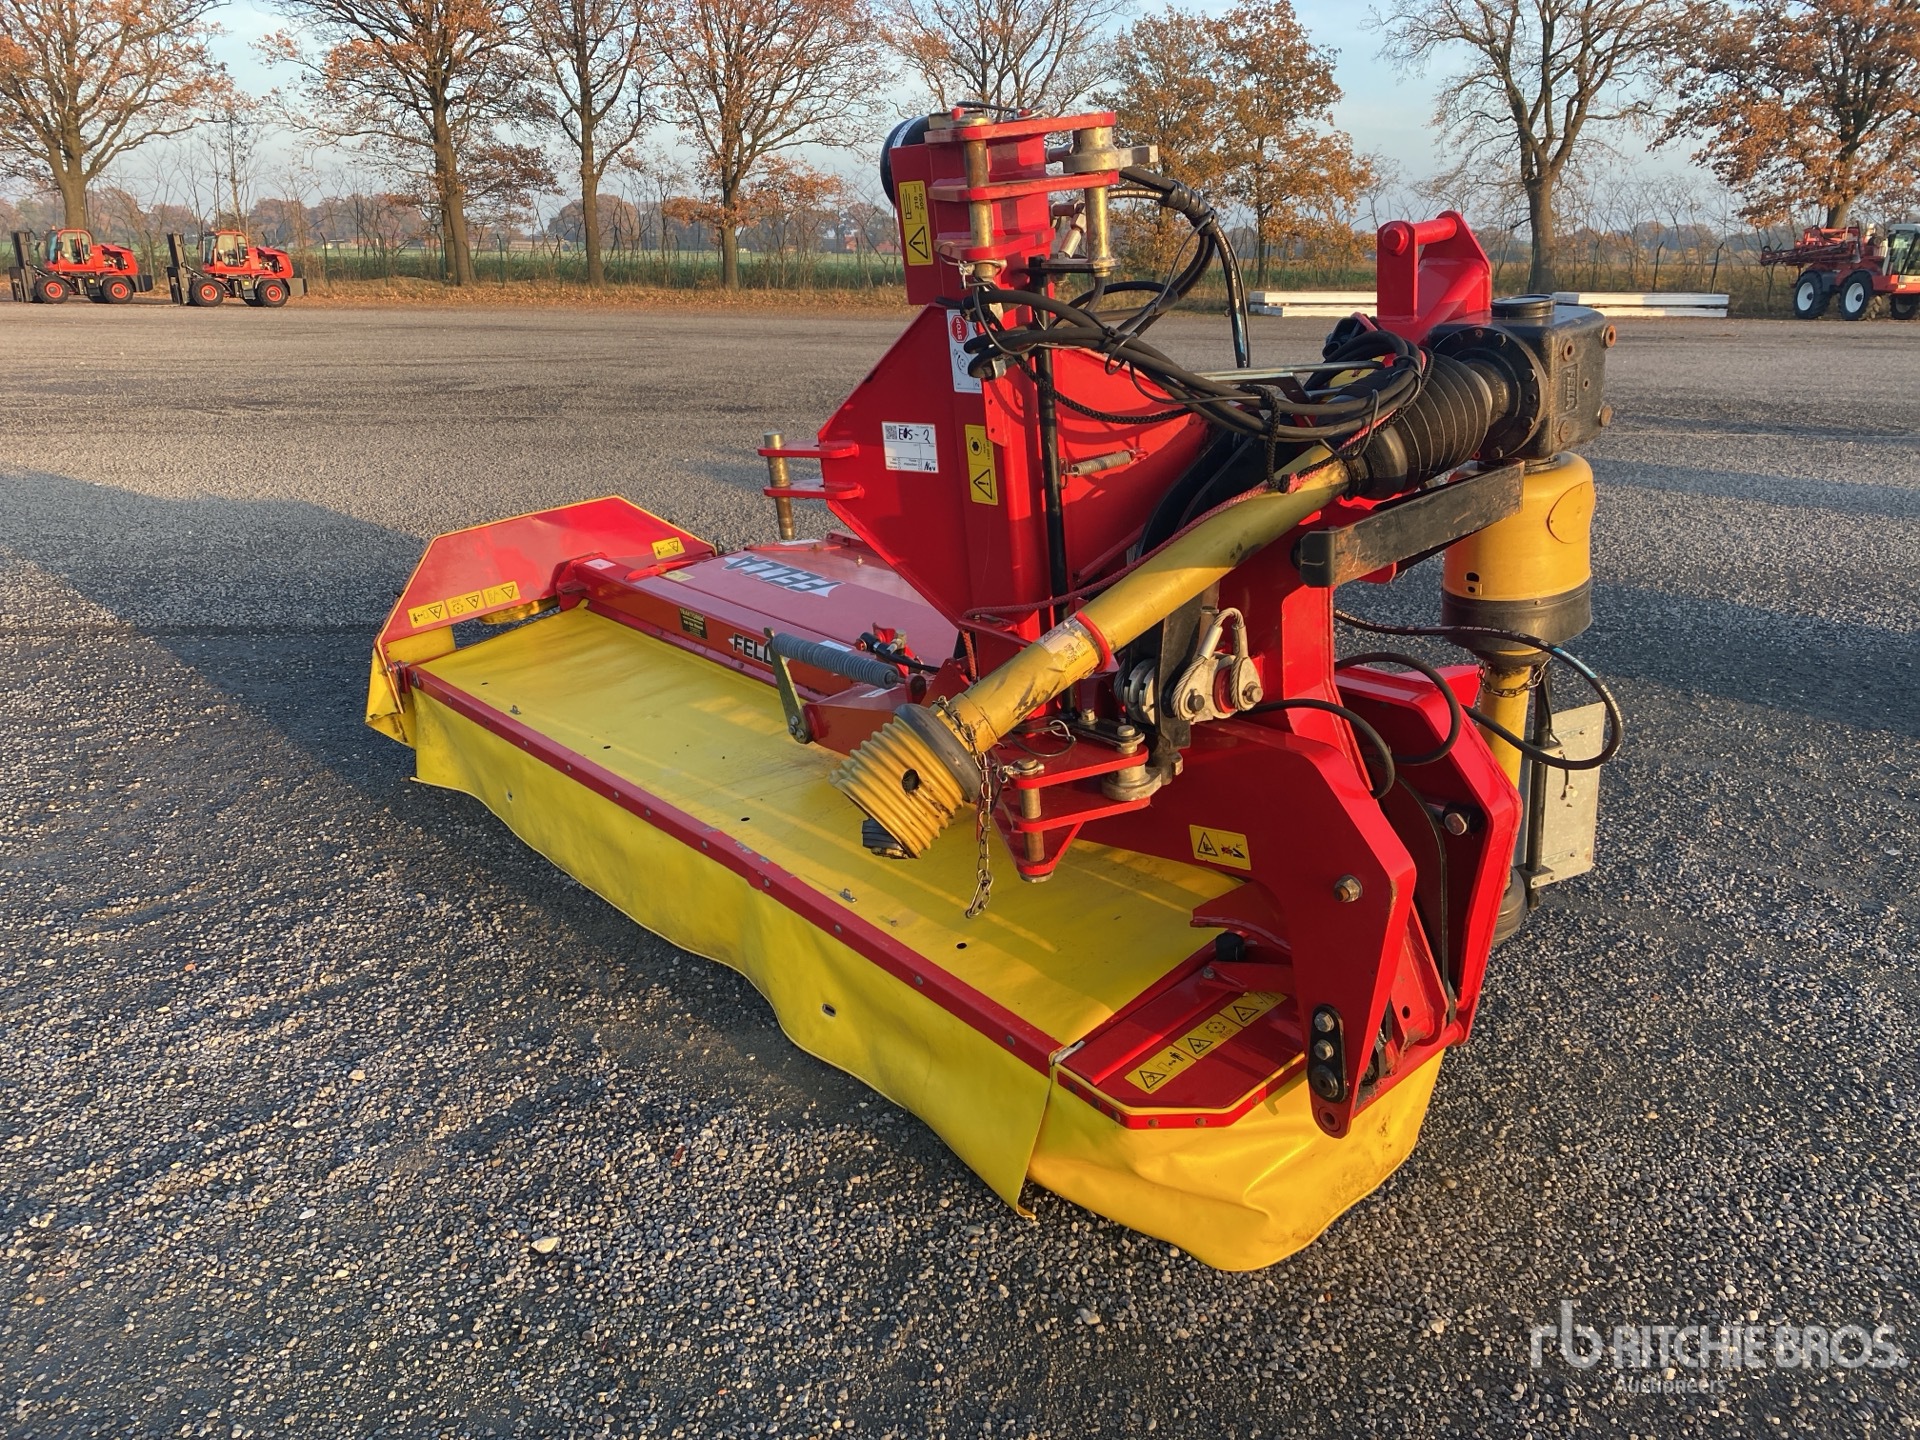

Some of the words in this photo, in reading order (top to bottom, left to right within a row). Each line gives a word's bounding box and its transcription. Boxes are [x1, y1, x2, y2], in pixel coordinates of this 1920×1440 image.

[955, 318, 963, 340] STOP
[724, 555, 842, 592] FELLA
[733, 633, 774, 666] FELL
